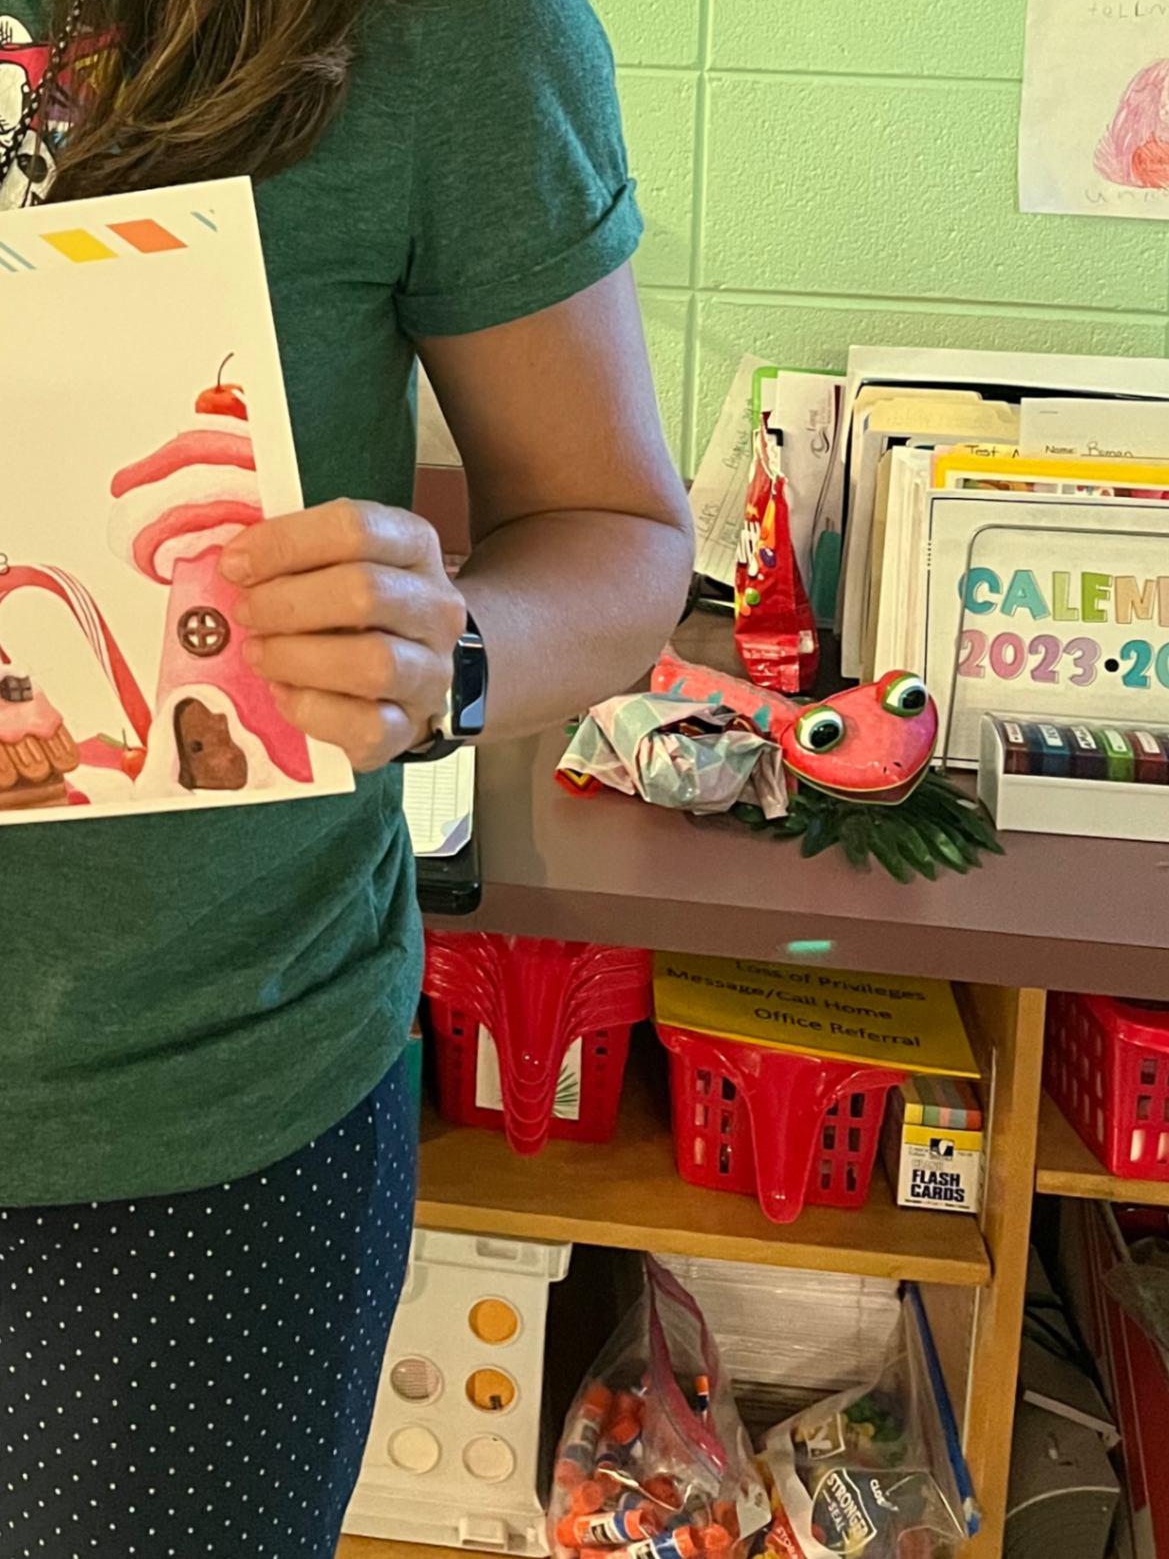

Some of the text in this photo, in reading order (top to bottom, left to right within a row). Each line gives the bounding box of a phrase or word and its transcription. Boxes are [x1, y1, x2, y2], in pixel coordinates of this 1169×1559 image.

[666, 967, 894, 1020] Message/Call Home
[735, 960, 927, 1001] Loss of Privileges
[754, 1007, 921, 1048] Office Referral
[910, 1183, 965, 1203] CARDS
[912, 1169, 961, 1188] FLASH
